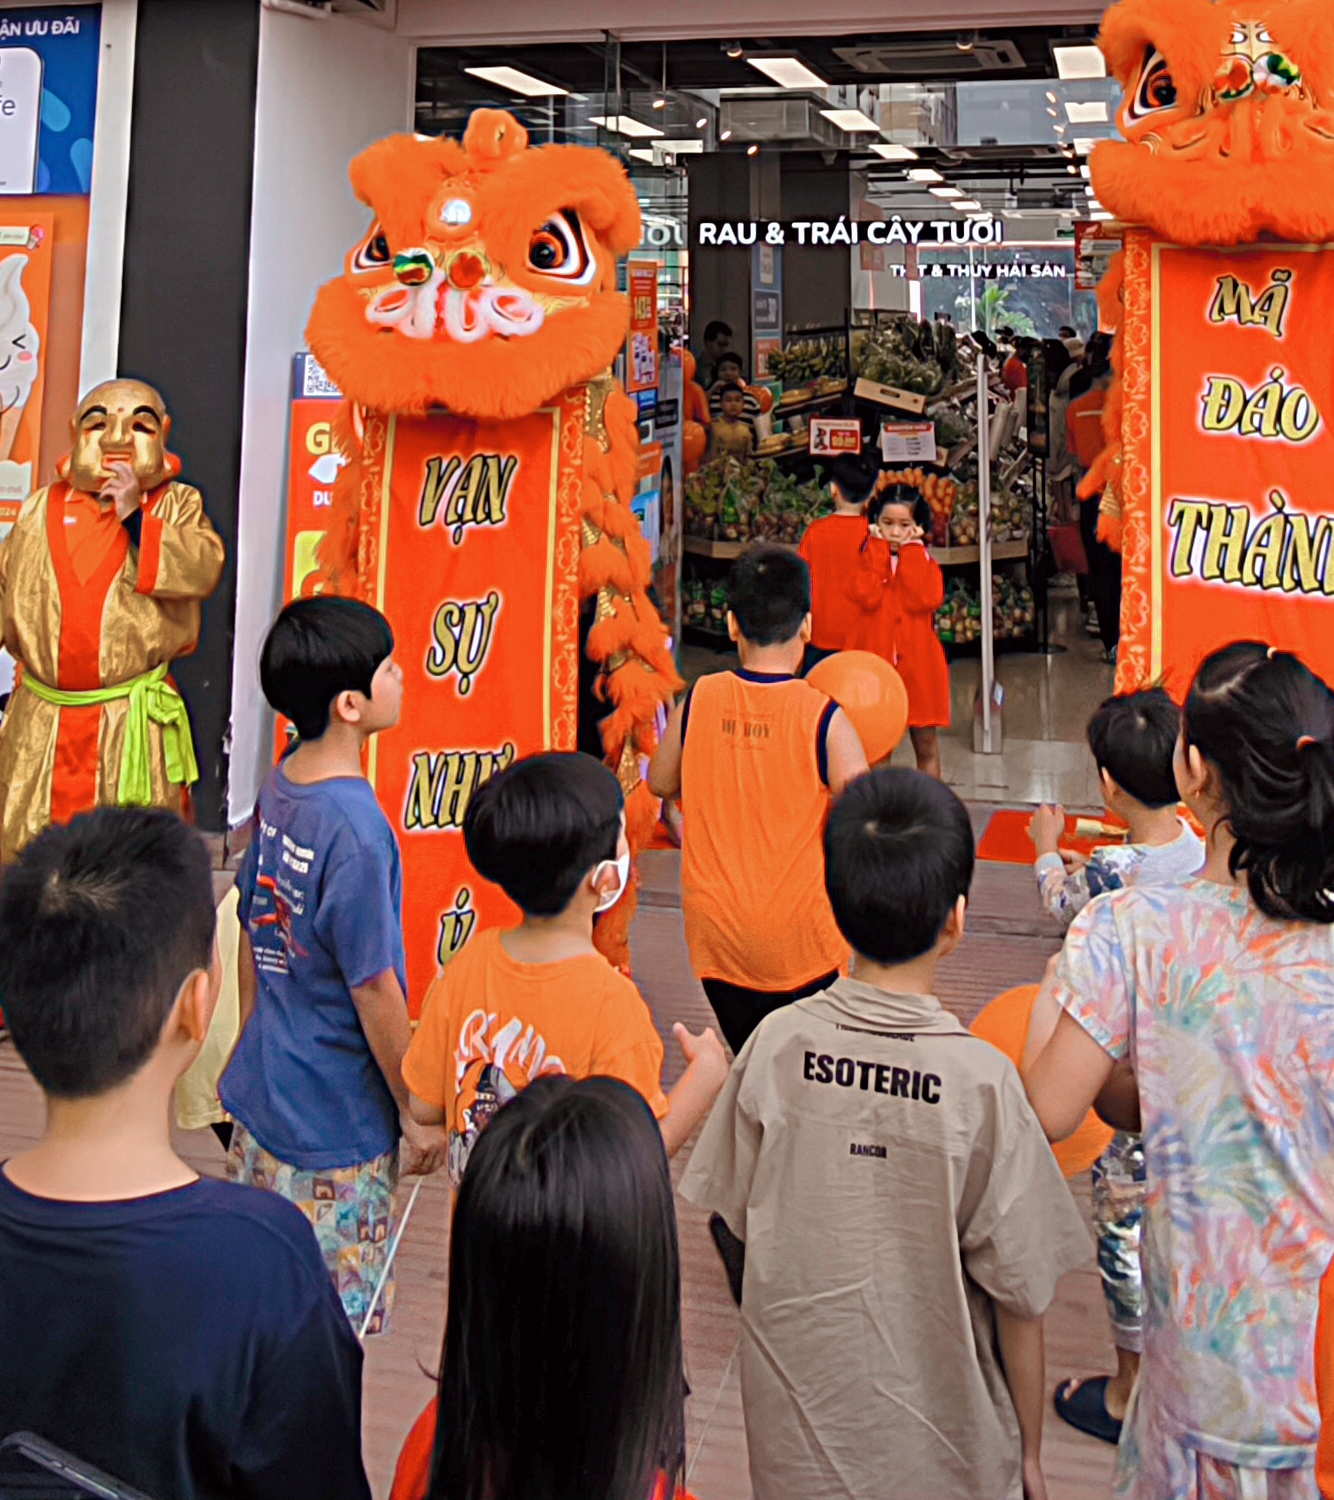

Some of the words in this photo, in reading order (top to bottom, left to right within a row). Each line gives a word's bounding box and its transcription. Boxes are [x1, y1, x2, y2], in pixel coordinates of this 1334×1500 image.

[24, 20, 48, 36] ƯU
[51, 17, 80, 35] ĐÃI
[699, 221, 757, 245] RAU
[765, 221, 785, 245] &
[792, 215, 858, 245] TRÁI
[867, 214, 924, 245] CÂY
[930, 215, 1003, 245] TƯƠI
[1211, 269, 1291, 337] MÃ
[1200, 367, 1319, 440] ĐÁO
[418, 454, 518, 545] VẠN
[425, 591, 500, 695] SỰ
[803, 1051, 942, 1104] ESOTERIC
[850, 1143, 887, 1159] RANCOR
